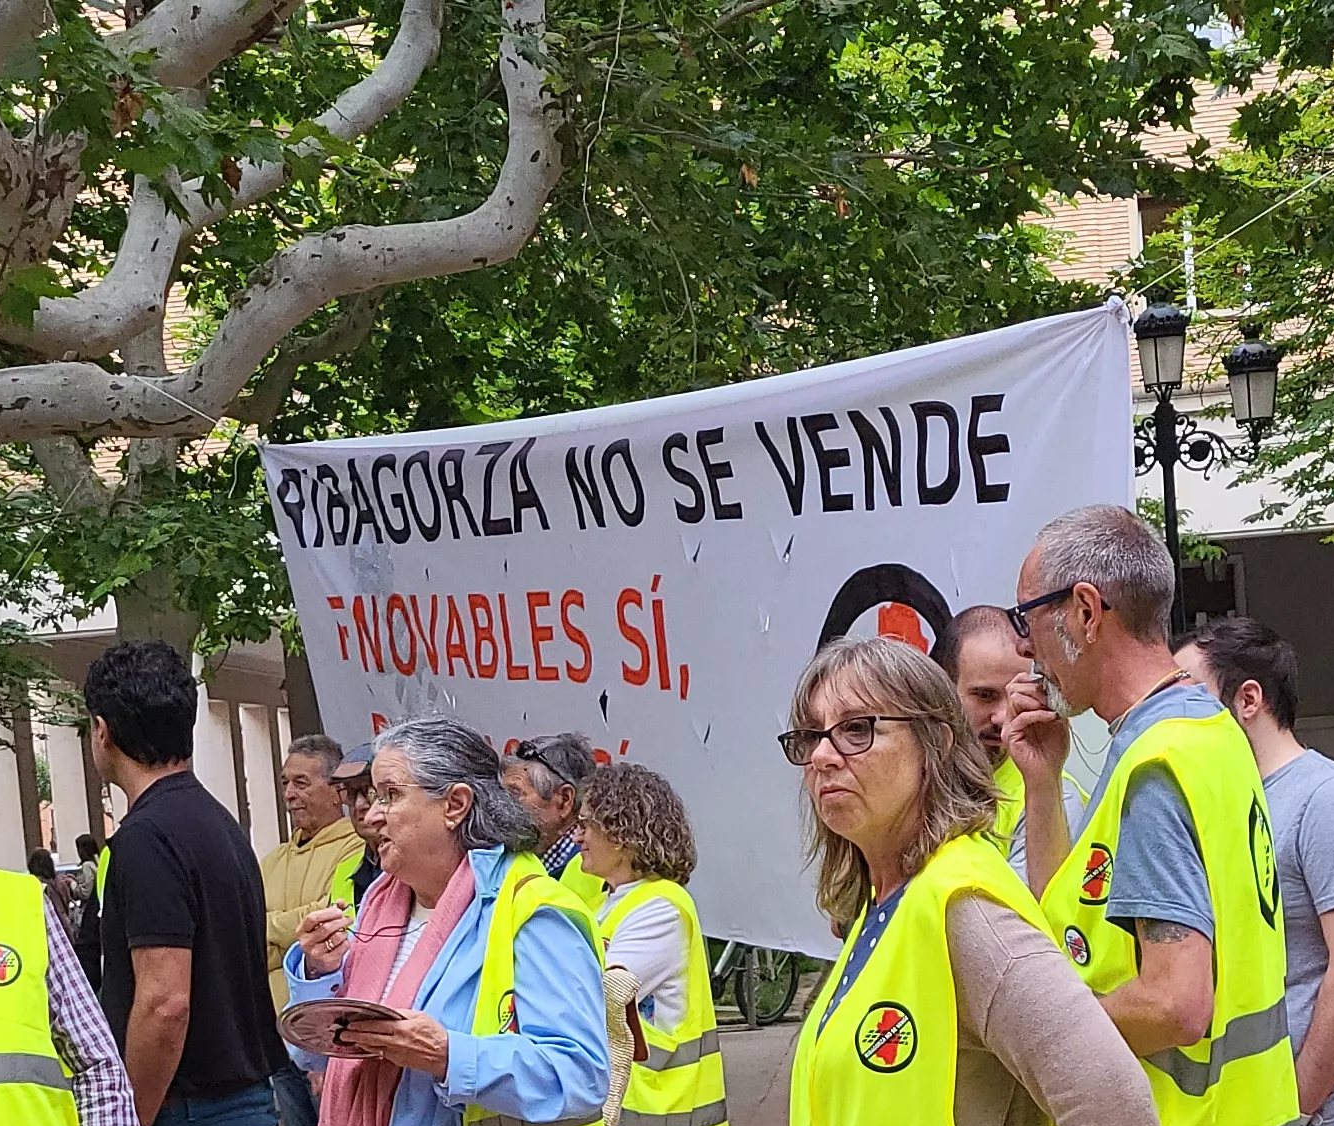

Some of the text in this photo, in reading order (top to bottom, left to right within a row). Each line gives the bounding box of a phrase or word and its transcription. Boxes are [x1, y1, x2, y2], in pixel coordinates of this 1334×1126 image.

[564, 438, 646, 531] NO
[661, 425, 744, 525] SE
[753, 392, 1012, 517] VENDE
